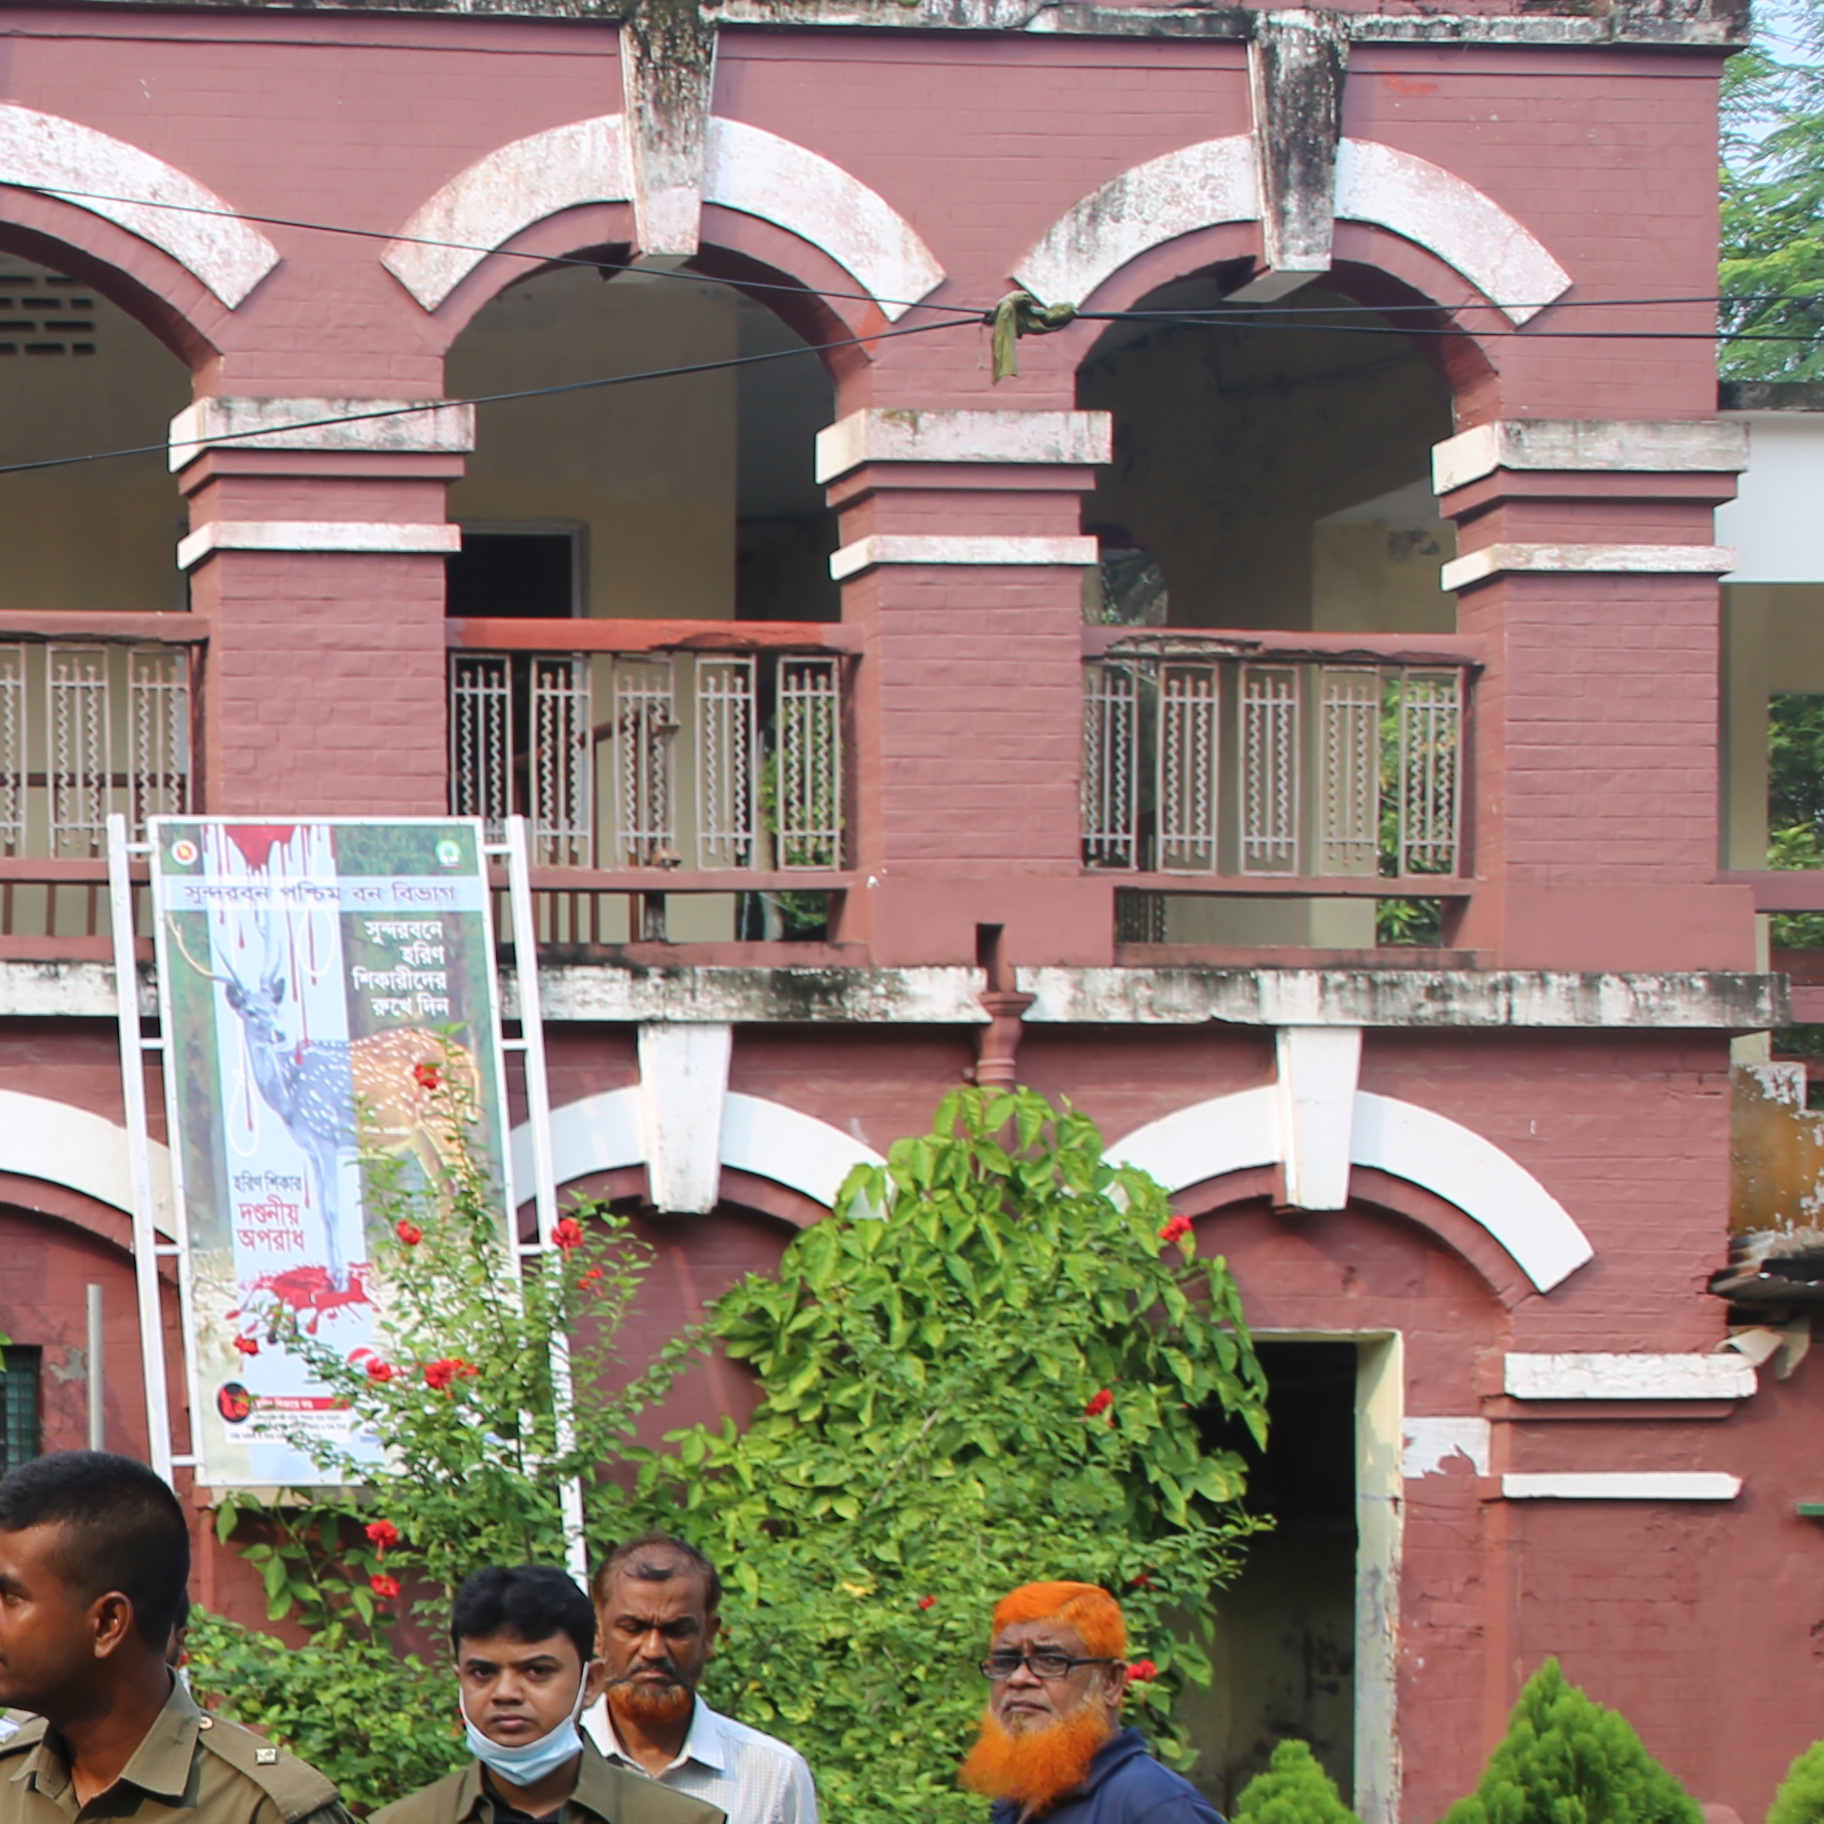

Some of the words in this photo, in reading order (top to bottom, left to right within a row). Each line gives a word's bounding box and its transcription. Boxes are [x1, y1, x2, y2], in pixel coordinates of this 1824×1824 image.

[183, 884, 269, 907] সুন্দরবন
[279, 880, 341, 903] পশ্চিম
[351, 886, 382, 902] বন
[391, 881, 456, 903] বিভাগ
[364, 920, 443, 946] সুন্দরবনে
[399, 944, 445, 967] হরিণ
[351, 964, 448, 992] শিকারীদের
[417, 992, 450, 1017] দিন
[232, 1169, 263, 1194] হরিণ
[236, 1228, 305, 1253] অপরাধ
